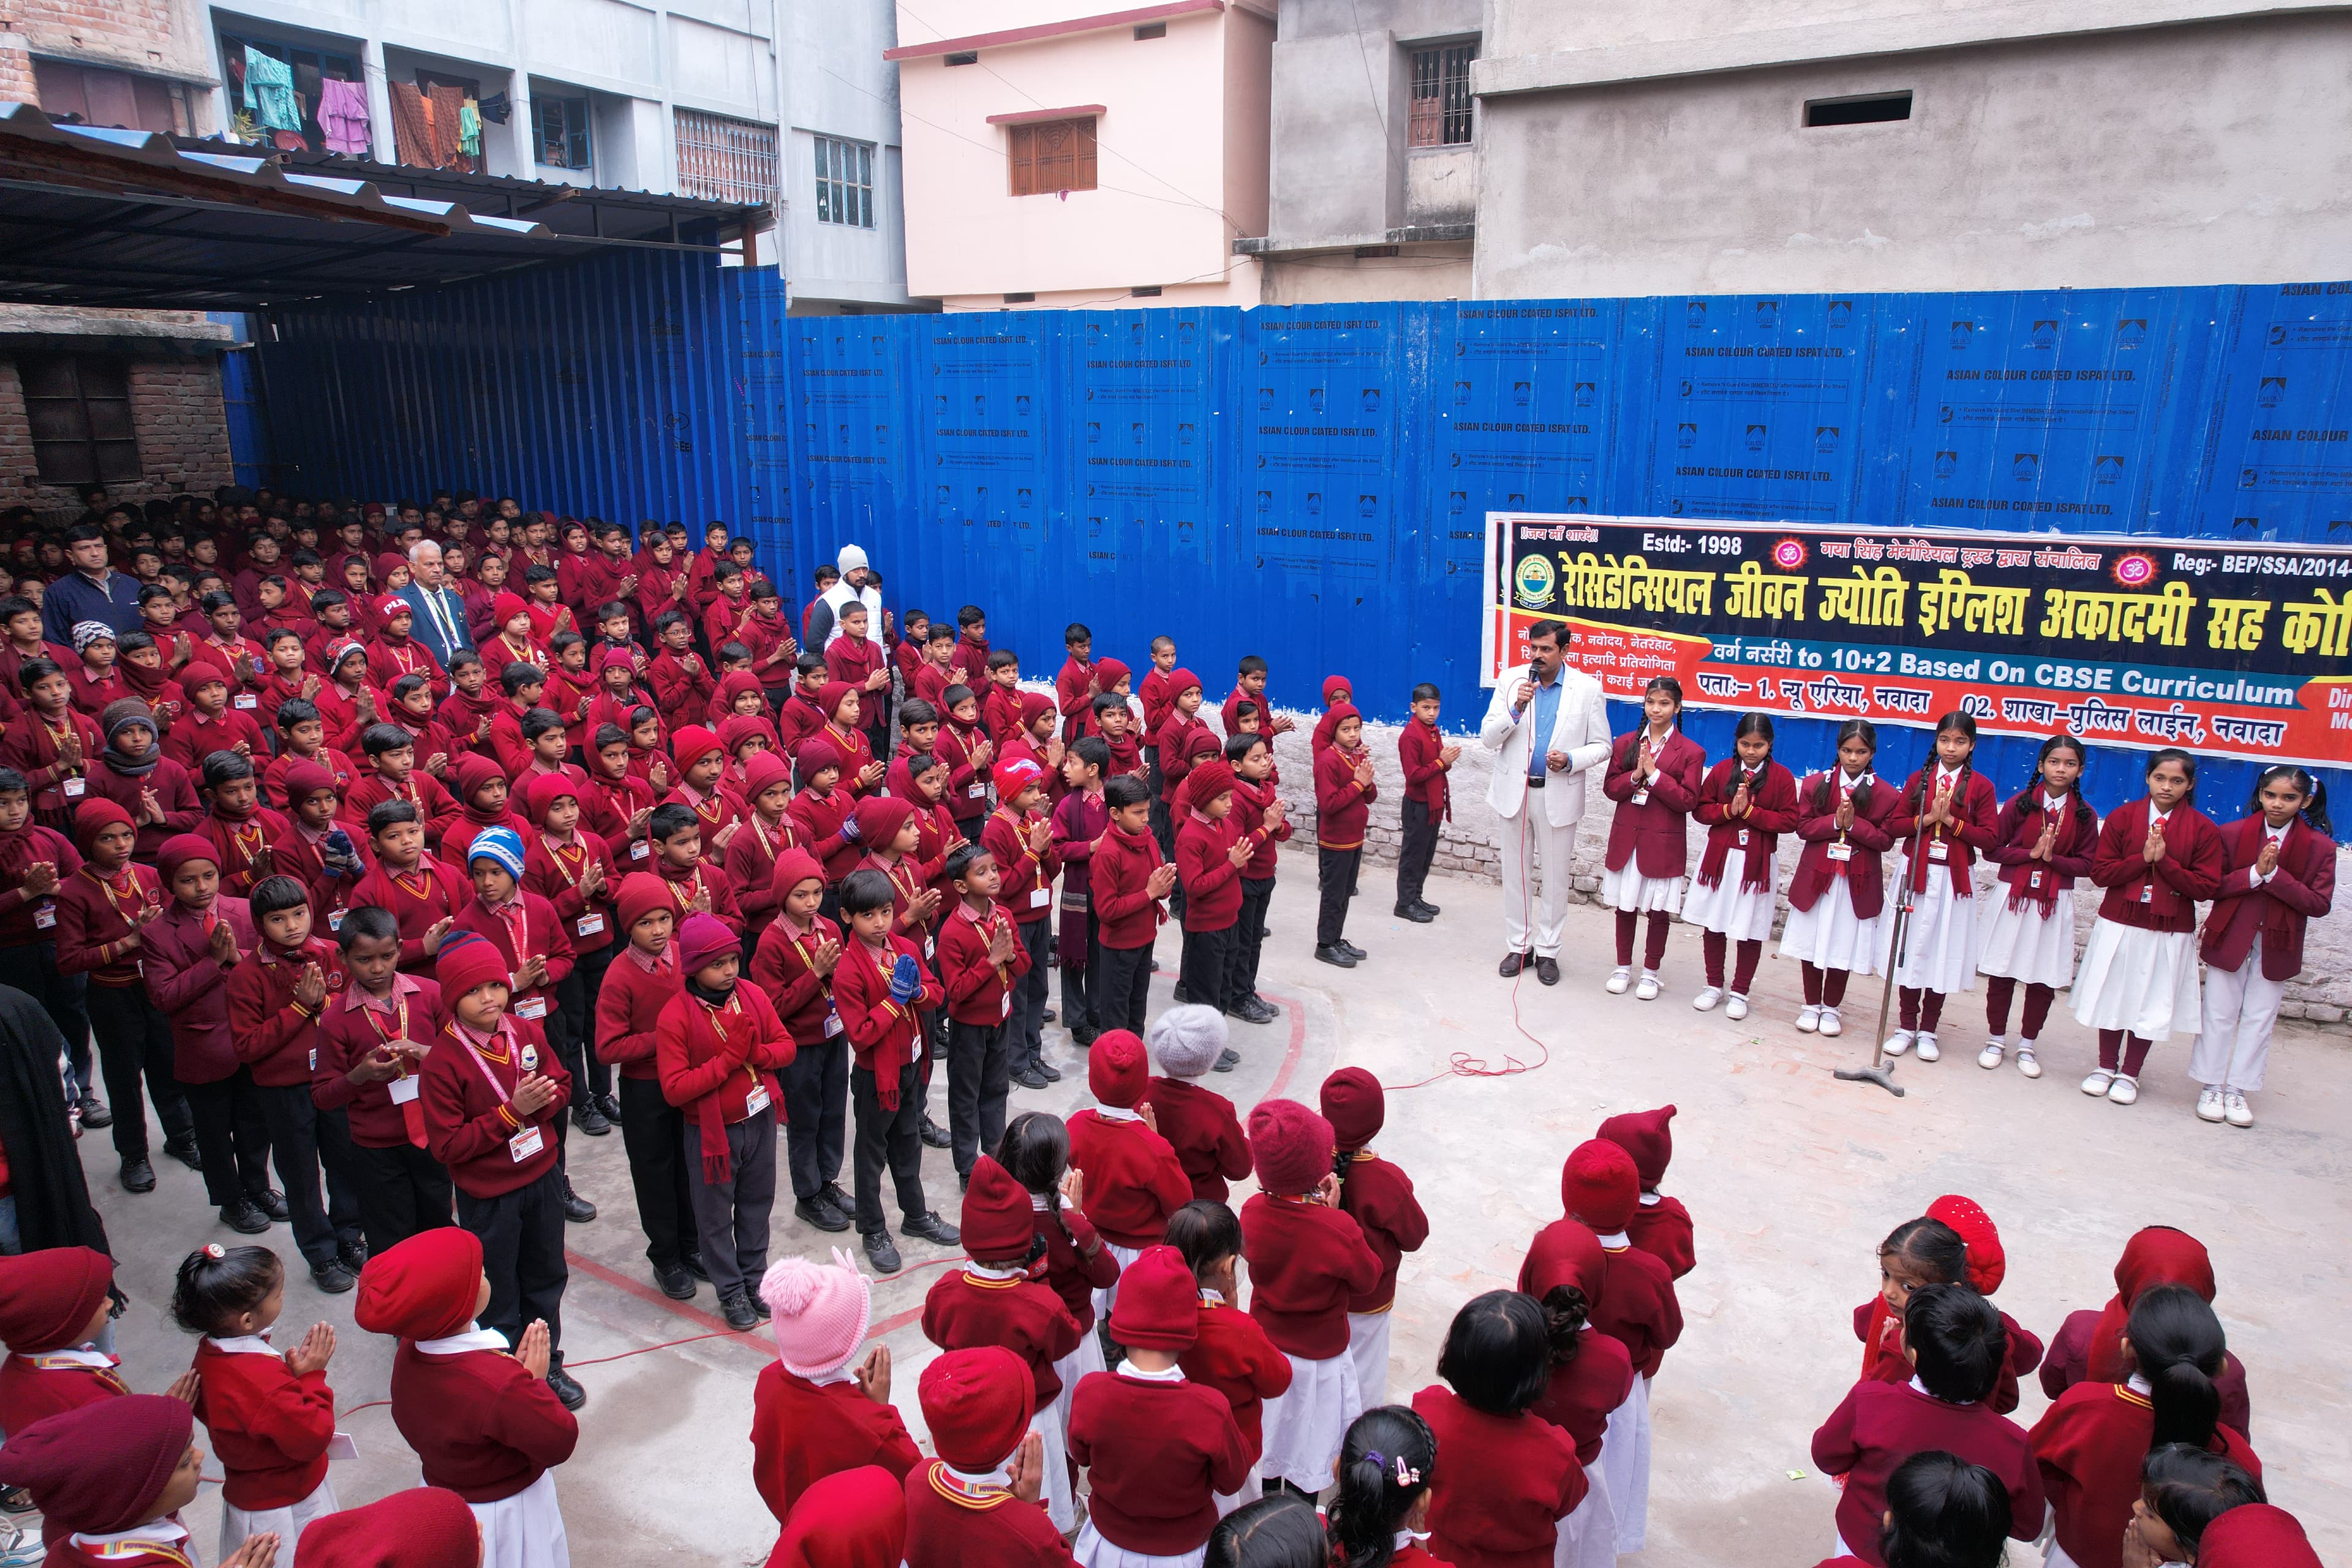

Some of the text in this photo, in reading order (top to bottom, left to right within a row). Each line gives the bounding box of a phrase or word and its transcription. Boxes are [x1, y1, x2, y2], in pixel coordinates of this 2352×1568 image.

[2281, 284, 2322, 296] ASIAN
[1458, 309, 1484, 318] ASIAN
[1580, 307, 1598, 317] LTD.
[1685, 347, 1714, 356] ASIAN
[1757, 347, 1792, 357] COATED
[1795, 347, 1822, 357] ISPAT
[1824, 347, 1845, 358] LTD.
[1947, 370, 1980, 380] ASIAN
[2030, 370, 2071, 381] COATED
[2076, 370, 2108, 381] ISPAT
[2111, 370, 2136, 381] LTD.
[1362, 428, 1378, 437] LTD.
[1453, 422, 1479, 431] ASIAN
[1573, 424, 1591, 434] LTD.
[2252, 430, 2348, 442] ASIAN COLOUR
[1676, 467, 1705, 476] ASIAN
[1746, 469, 1781, 479] COATED
[1784, 470, 1810, 481] ISPAT
[1812, 471, 1833, 481] LTD.
[1931, 497, 1964, 508] ASIAN
[2012, 500, 2052, 512] COATED
[2056, 502, 2087, 514] ISPAT
[2089, 503, 2113, 515] LTD.
[1359, 533, 1374, 541] LTD.
[1449, 530, 1474, 540] ASIAN
[1550, 526, 1564, 541] माँ
[1643, 533, 1742, 555] Estd:- 1998
[1820, 537, 2101, 570] गया सिंह मेमोरियल ट्रस्ट द्वारा संचालित
[2173, 552, 2217, 576] Reg:-
[1558, 551, 1716, 616] रेसिडेन्सियल
[1724, 560, 1809, 620] जीवन
[1818, 565, 1910, 627] ज्योति
[2040, 581, 2197, 647] अकादमी
[2207, 598, 2271, 650] सह
[1588, 631, 1626, 650] नवोदय,
[1630, 634, 1676, 654] नेतरहाट,
[1582, 651, 1616, 666] इत्यादि
[1619, 654, 1676, 672] प्रतियोगिता
[1713, 638, 2294, 705] वर्ग नर्सरी to 10+2 Based On CBSE Curriculum
[1607, 673, 1634, 689] कराई
[1757, 678, 1776, 700] 1.
[1780, 679, 1806, 711] न्यू
[1808, 675, 1869, 713] एरिया,
[1874, 688, 1932, 714] नवादा
[1961, 695, 1997, 719] 02.
[2135, 703, 2206, 744] लाईन,
[2212, 717, 2287, 747] नवादा
